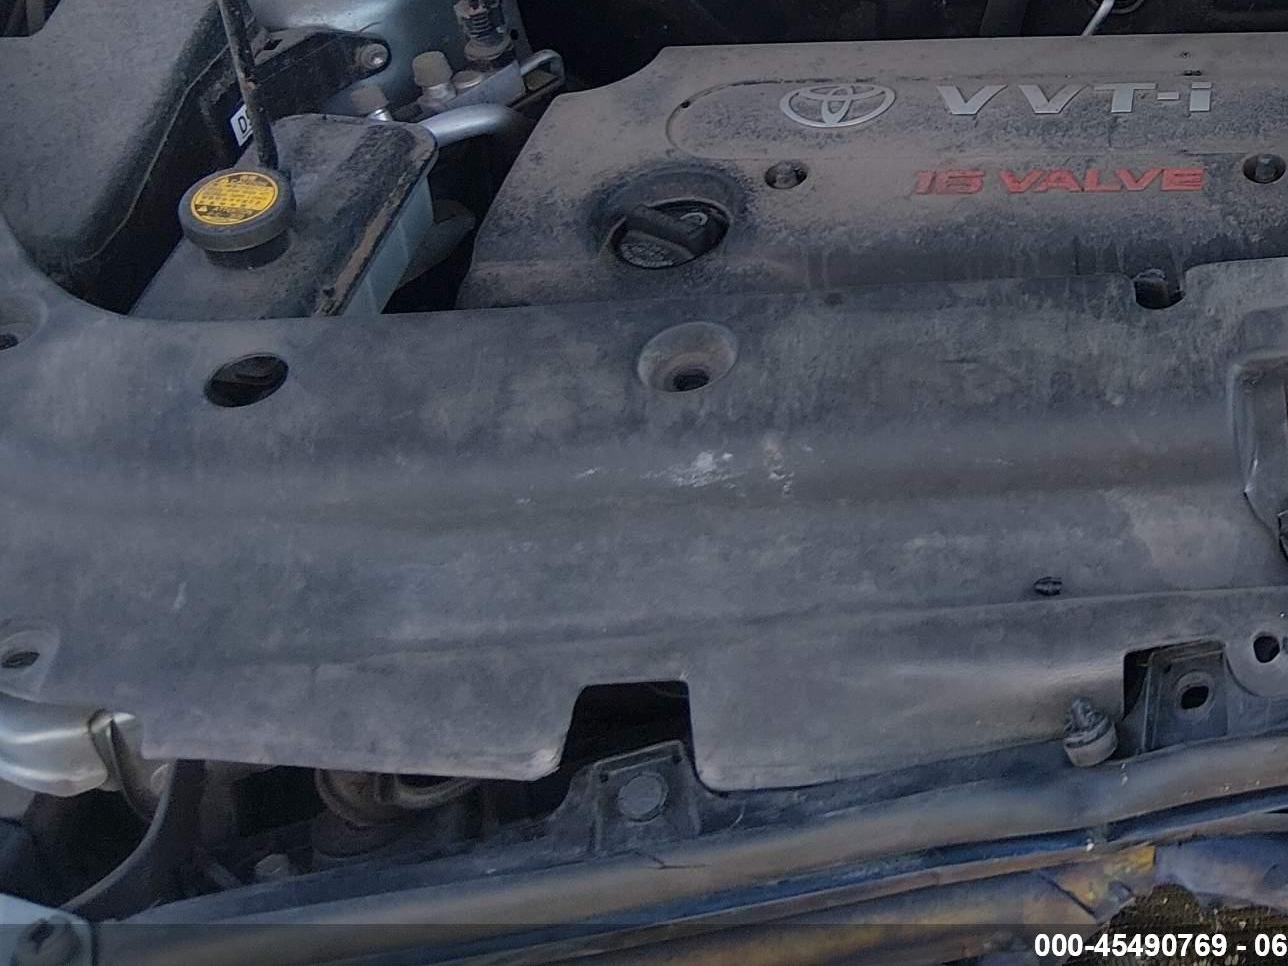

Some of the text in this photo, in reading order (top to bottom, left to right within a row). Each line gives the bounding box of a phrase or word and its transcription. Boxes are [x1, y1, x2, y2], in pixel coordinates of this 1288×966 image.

[936, 81, 1213, 116] VVT-i
[914, 167, 1207, 195] 16 VALVE
